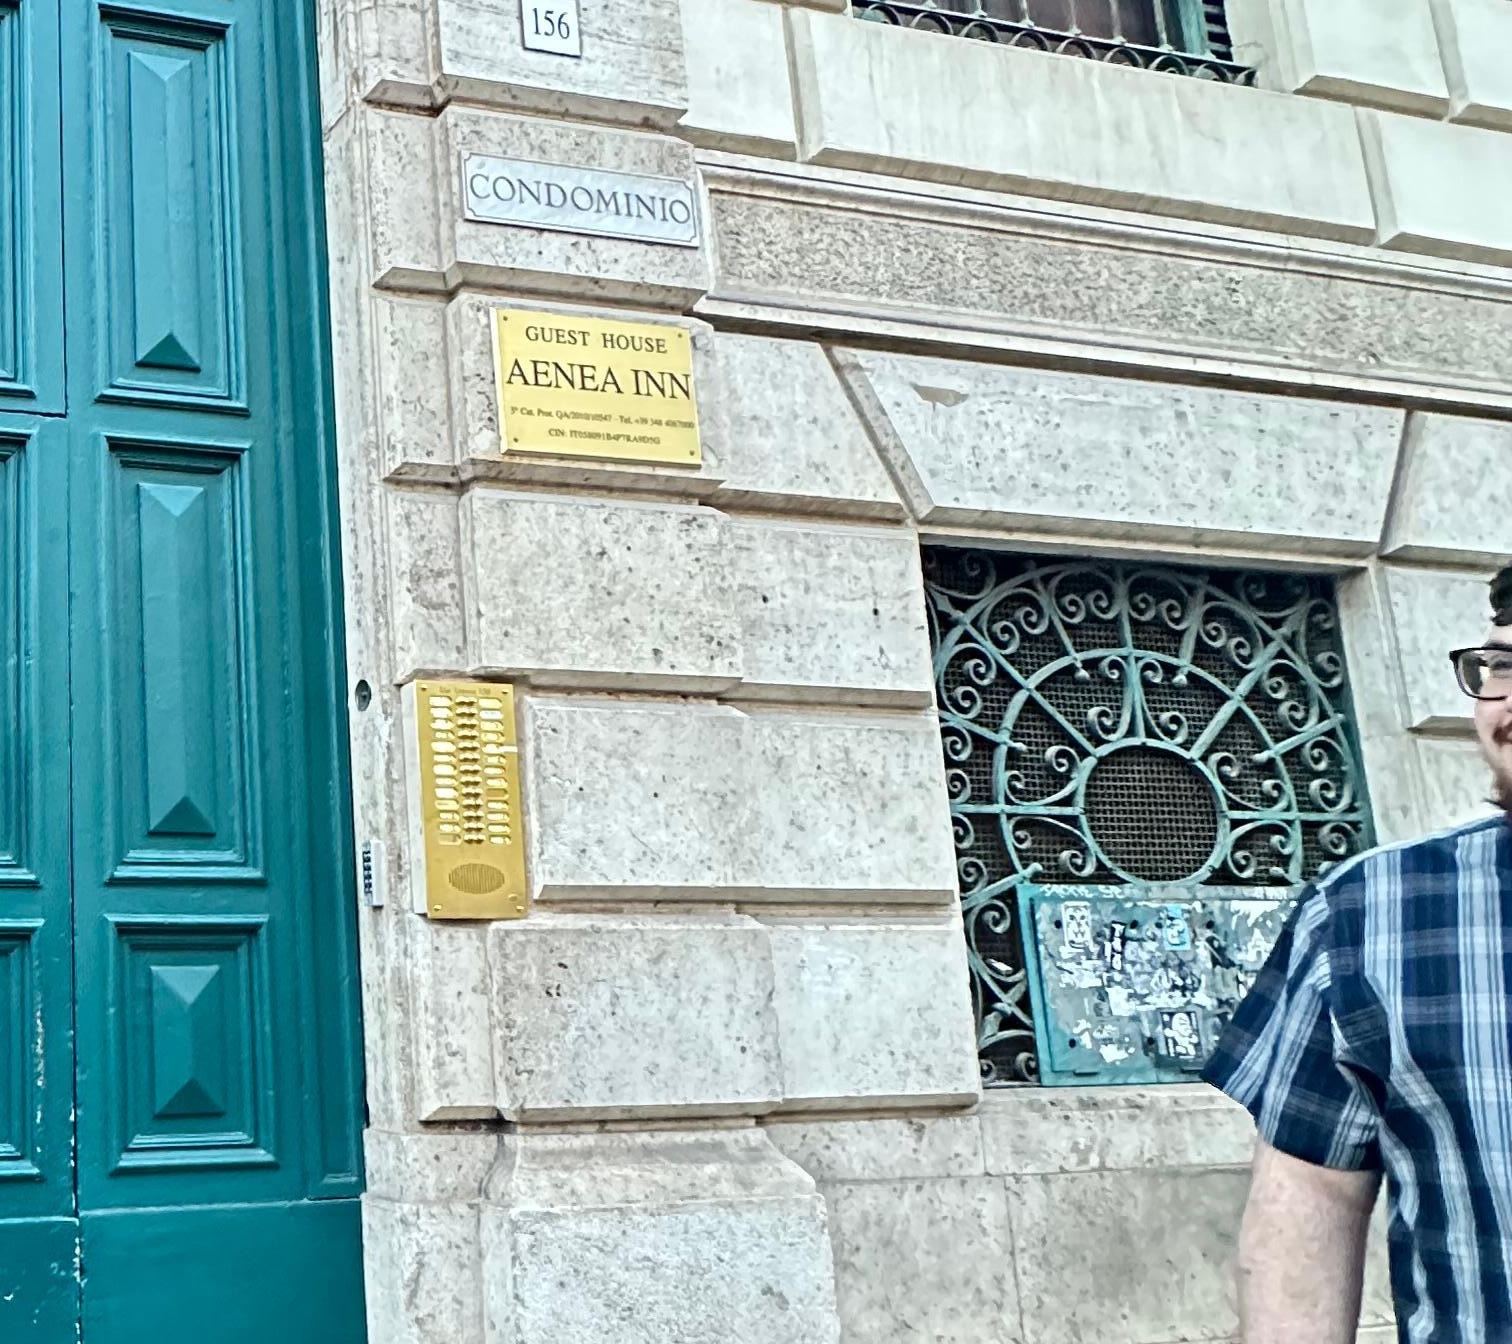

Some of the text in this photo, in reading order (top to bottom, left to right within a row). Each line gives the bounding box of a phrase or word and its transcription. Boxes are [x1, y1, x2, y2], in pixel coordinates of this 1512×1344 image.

[532, 7, 570, 40] 156
[469, 173, 691, 224] CONDOMINIO
[525, 325, 668, 354] GUEST HOUSE
[506, 358, 691, 401] AENEA INN
